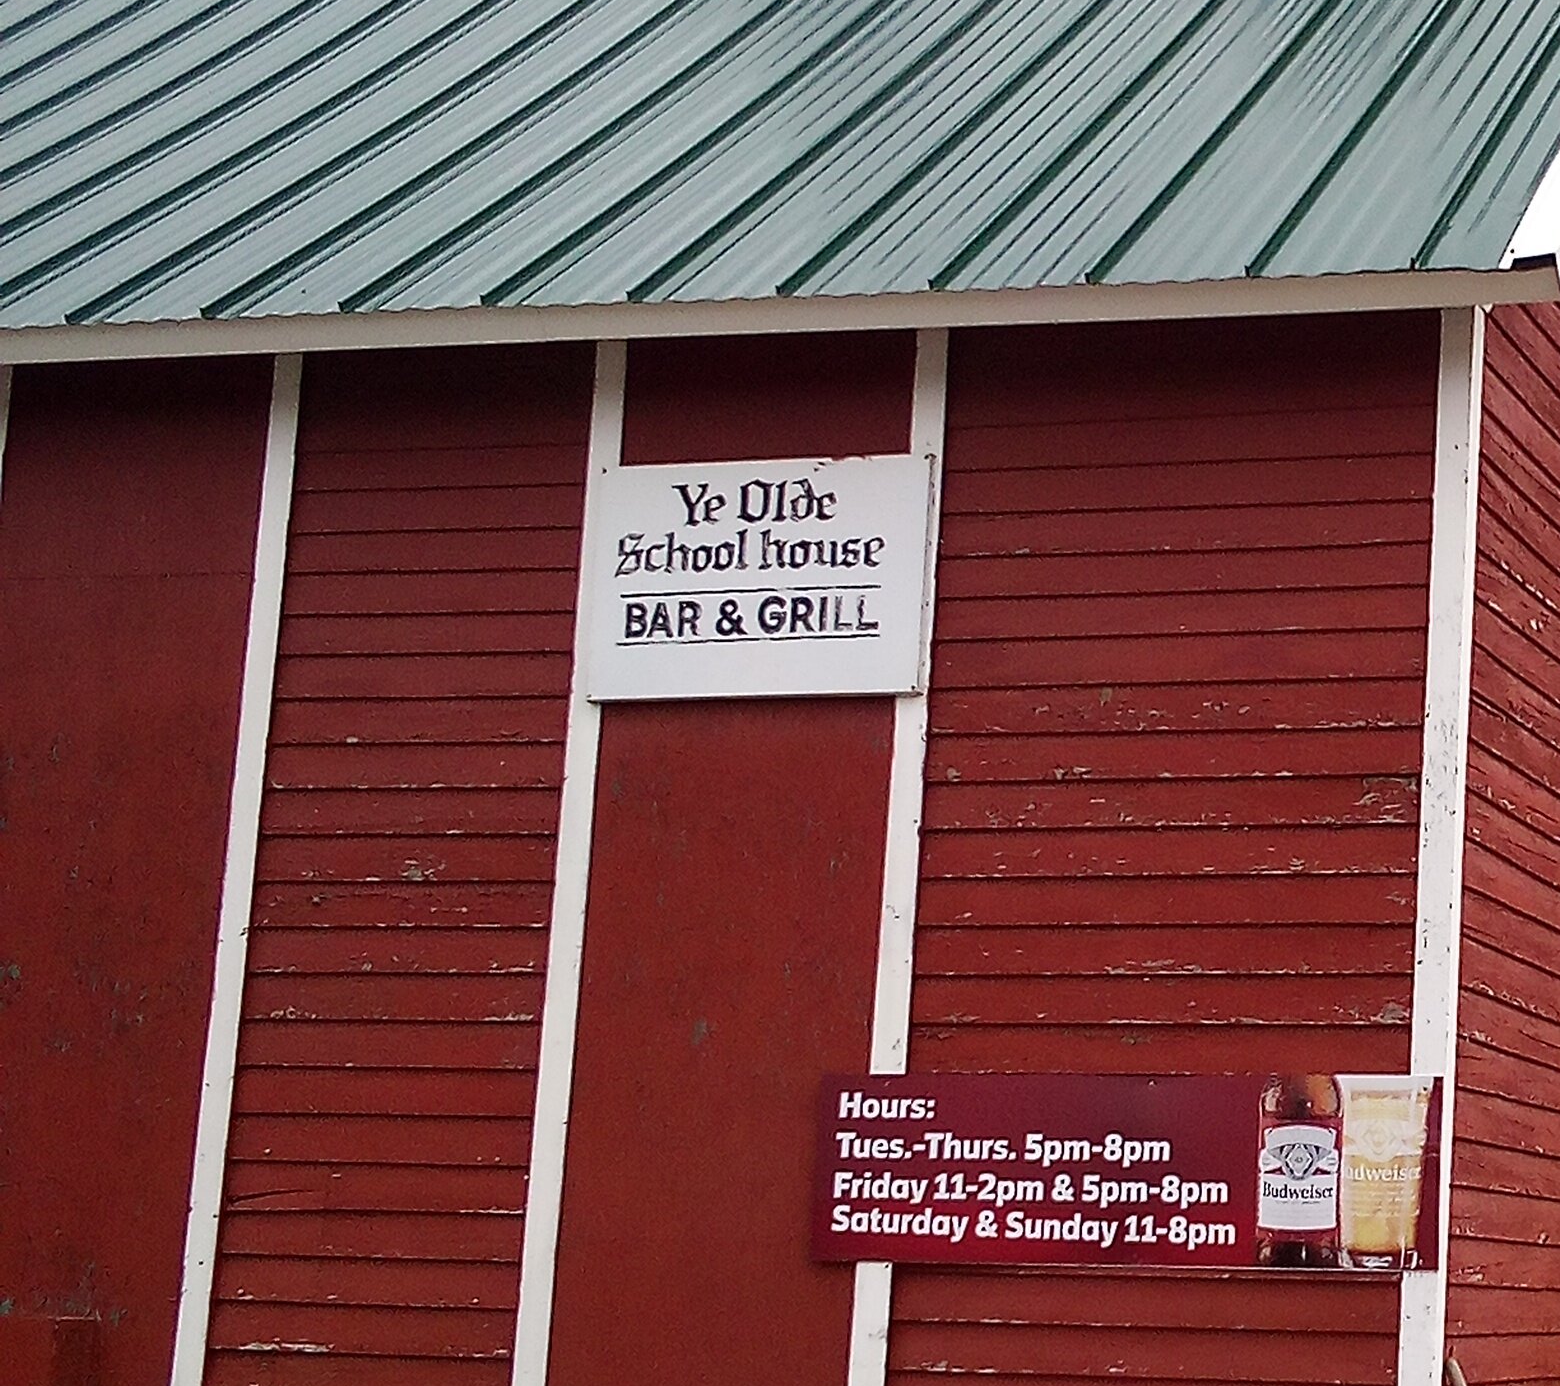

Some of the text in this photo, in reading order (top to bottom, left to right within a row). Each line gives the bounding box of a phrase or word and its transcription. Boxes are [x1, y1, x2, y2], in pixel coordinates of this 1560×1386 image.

[672, 477, 838, 527] Ye Olde
[615, 528, 885, 578] School house
[624, 595, 879, 639] BAR & GRILL
[838, 1091, 936, 1120] Hours:
[836, 1132, 1171, 1168] Tues.-Thurs. 5pm-8pm
[832, 1172, 1229, 1210] Friday 11-2pm & 5pm-8pm
[1263, 1181, 1333, 1199] Budweiser
[830, 1205, 1236, 1251] Saturday & Sunday 11-8pm
